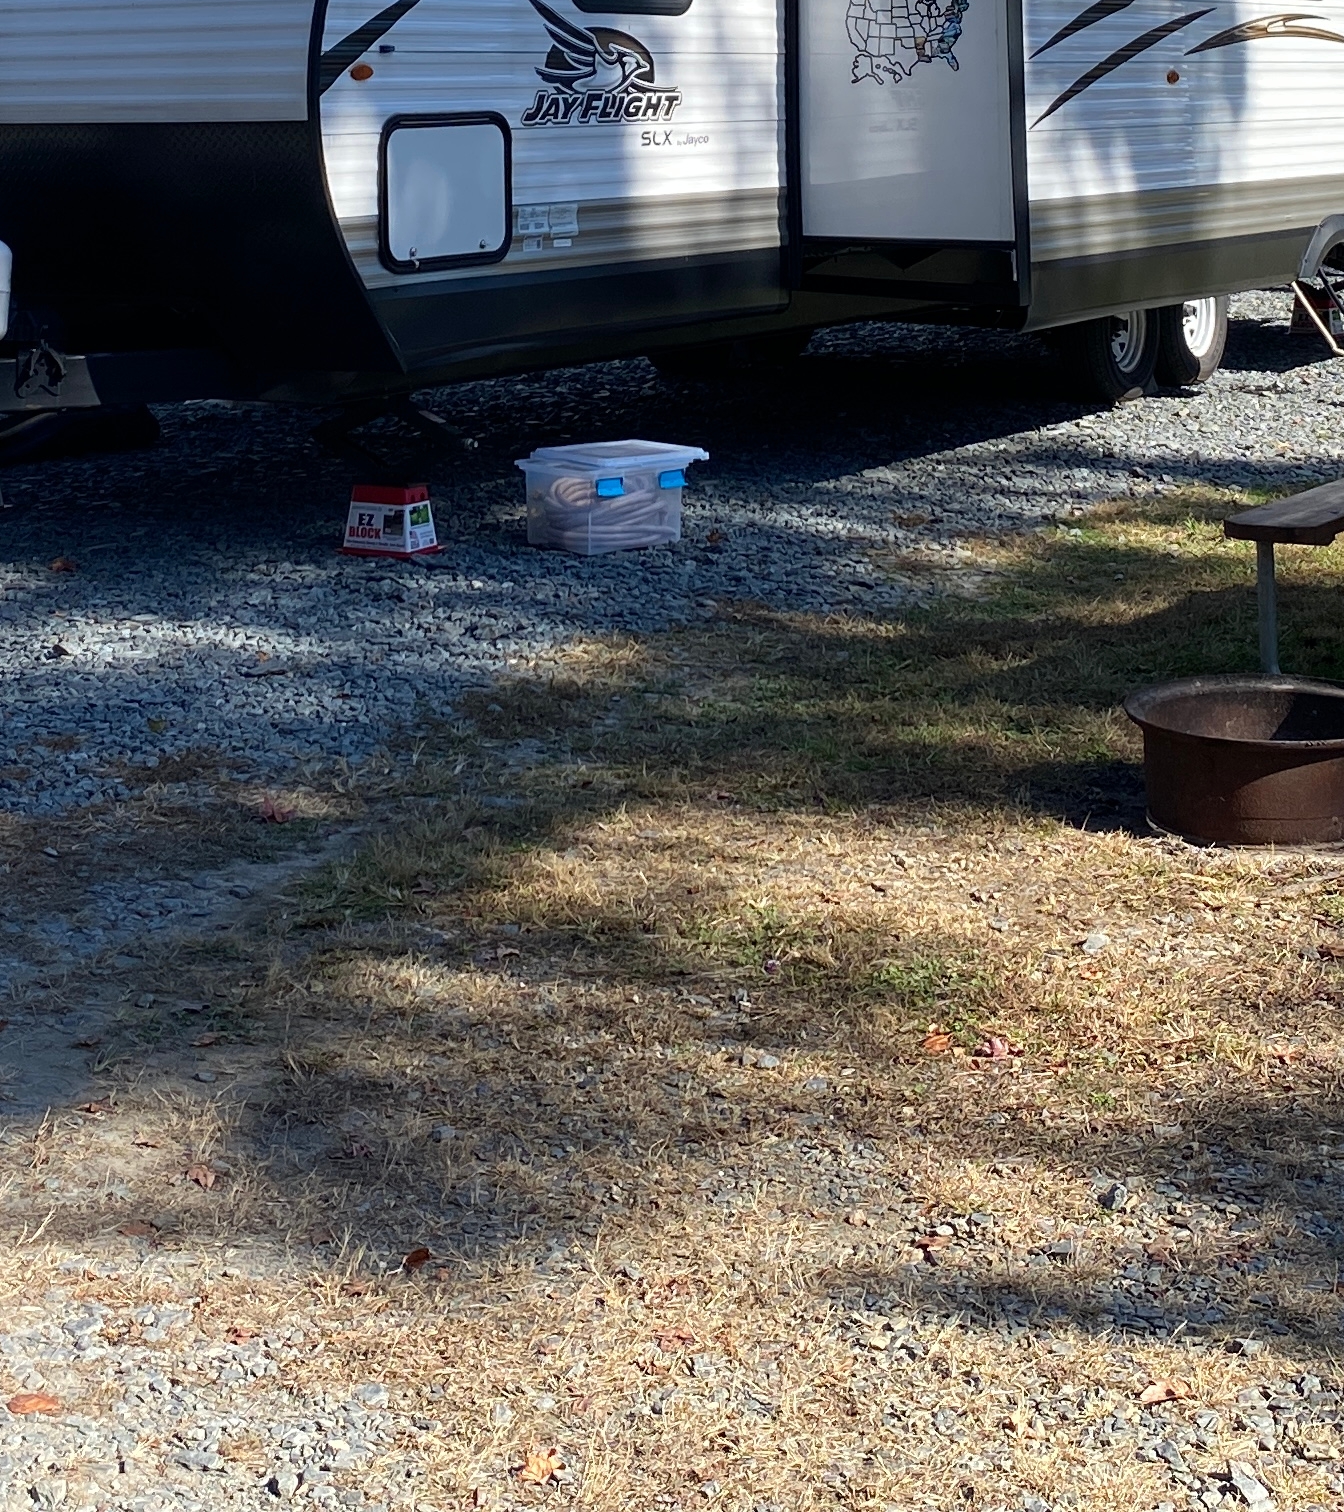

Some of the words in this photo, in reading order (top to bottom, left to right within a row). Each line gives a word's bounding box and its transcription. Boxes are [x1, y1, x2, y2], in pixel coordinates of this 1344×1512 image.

[641, 130, 674, 146] SLX
[682, 132, 710, 147] Jayco
[358, 512, 375, 527] EZ
[348, 525, 381, 540] BLOCK
